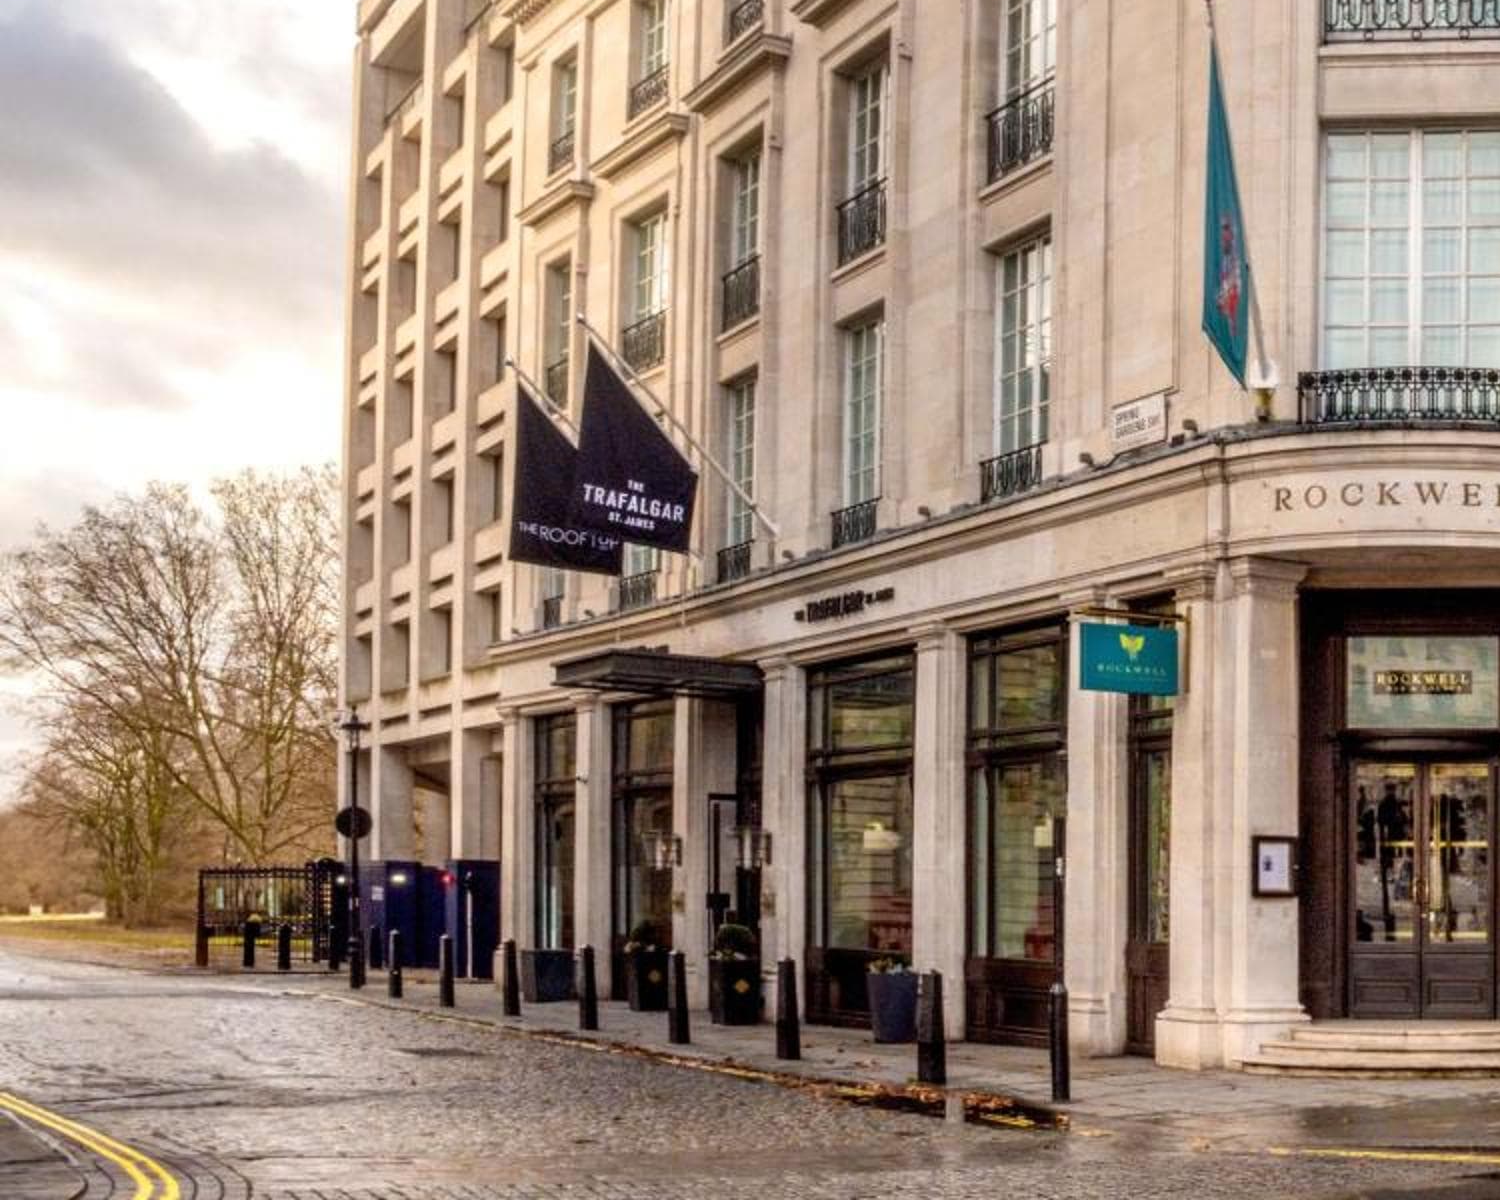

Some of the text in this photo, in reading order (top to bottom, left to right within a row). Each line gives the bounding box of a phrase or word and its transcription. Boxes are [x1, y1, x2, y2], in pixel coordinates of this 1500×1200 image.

[627, 479, 645, 493] THE
[582, 483, 685, 523] TRAFALGAR
[624, 515, 656, 531] JAMES
[1376, 672, 1468, 686] ROCKWELL
